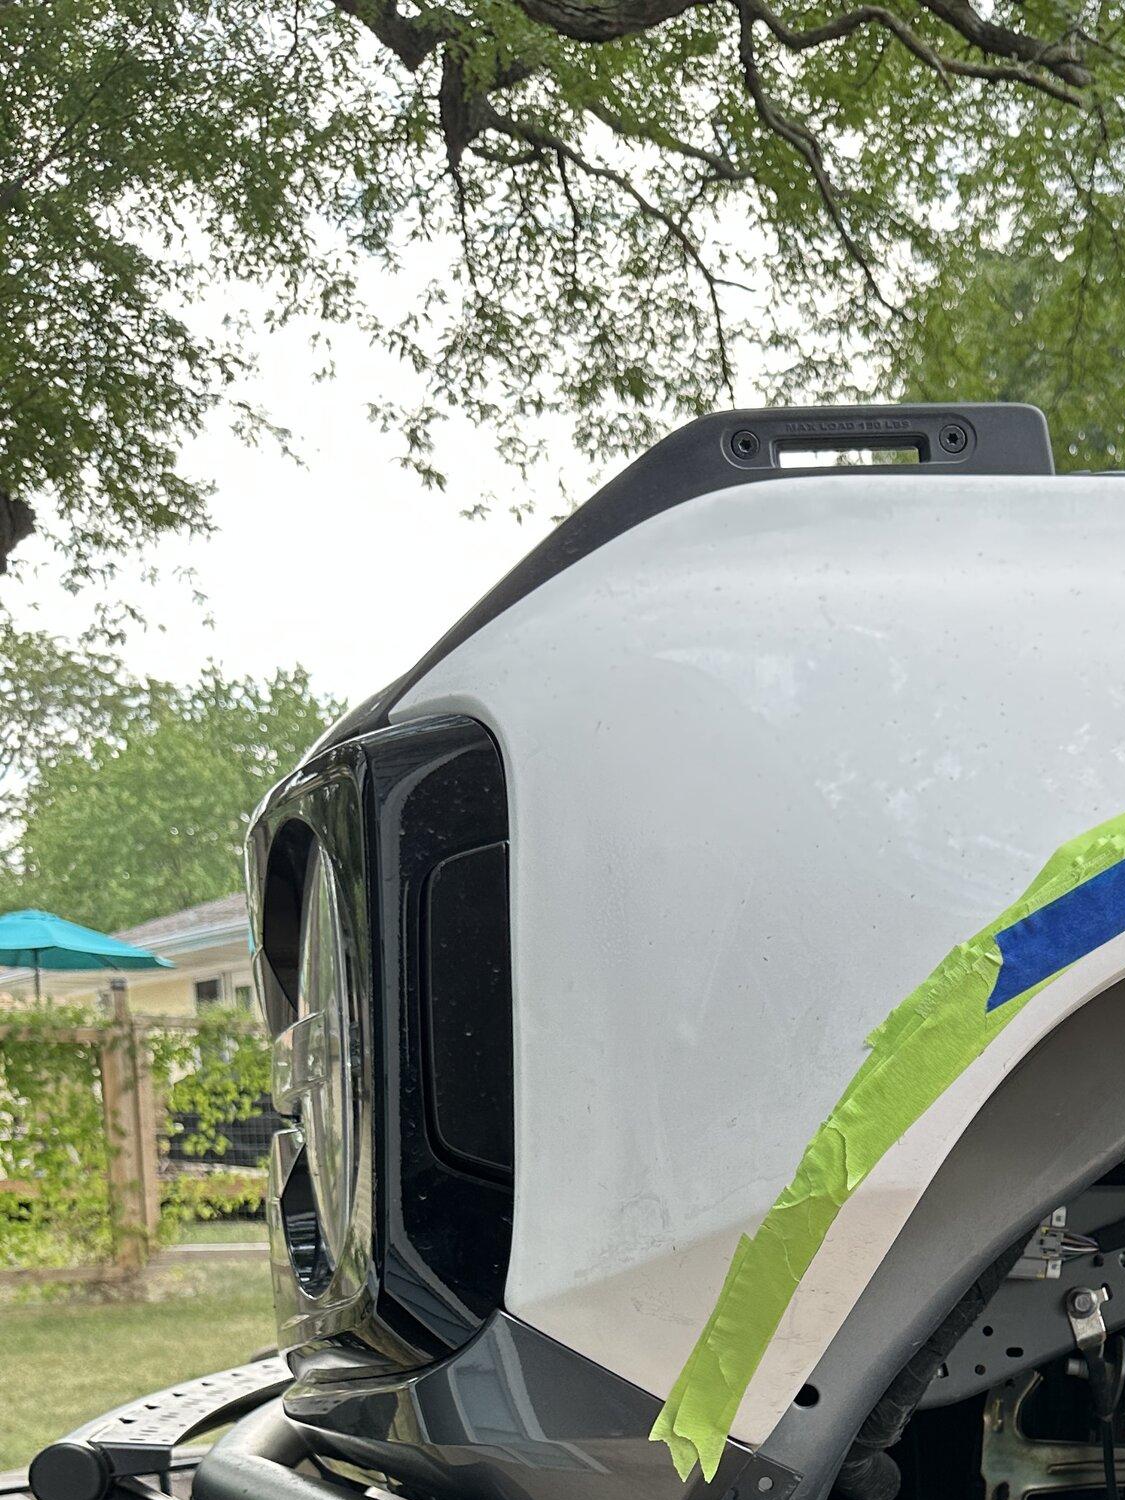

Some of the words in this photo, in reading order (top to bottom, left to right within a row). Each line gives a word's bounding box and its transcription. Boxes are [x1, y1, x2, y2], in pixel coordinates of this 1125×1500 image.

[785, 421, 817, 432] MAX
[820, 421, 854, 431] LOAD
[885, 419, 912, 429] LBS
